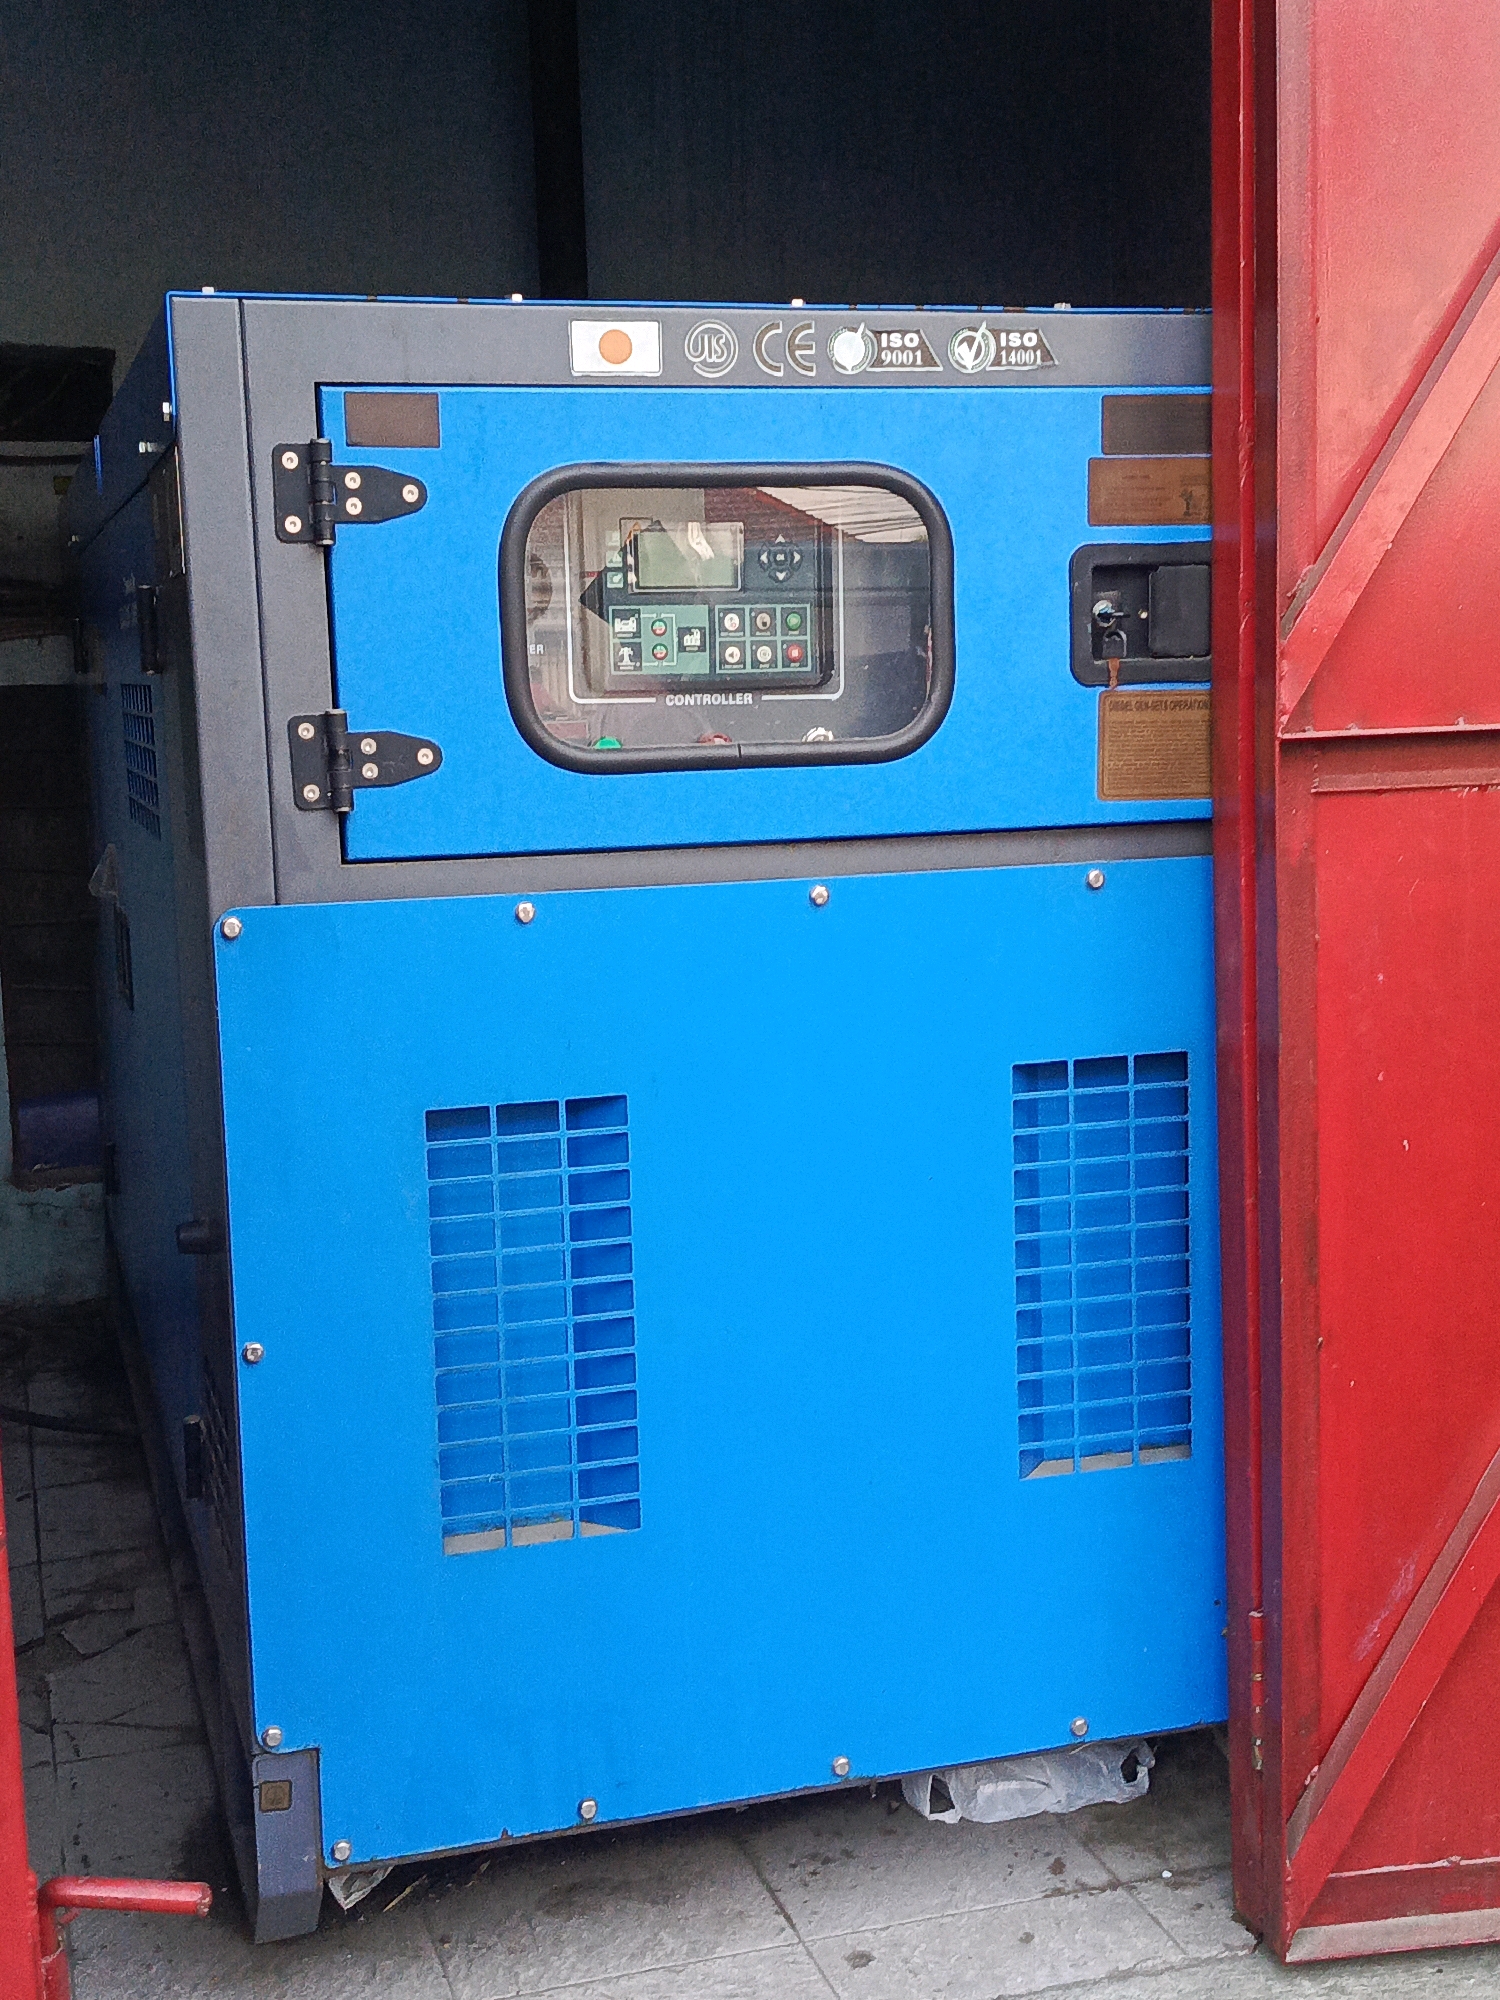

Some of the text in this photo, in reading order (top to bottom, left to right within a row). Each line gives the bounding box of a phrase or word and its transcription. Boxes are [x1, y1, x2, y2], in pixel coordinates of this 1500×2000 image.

[881, 332, 920, 348] ISO
[1000, 332, 1038, 347] ISO
[753, 320, 816, 377] CE
[881, 349, 924, 366] 9001
[1000, 348, 1041, 366] 14001
[665, 692, 753, 706] CONTROLLER
